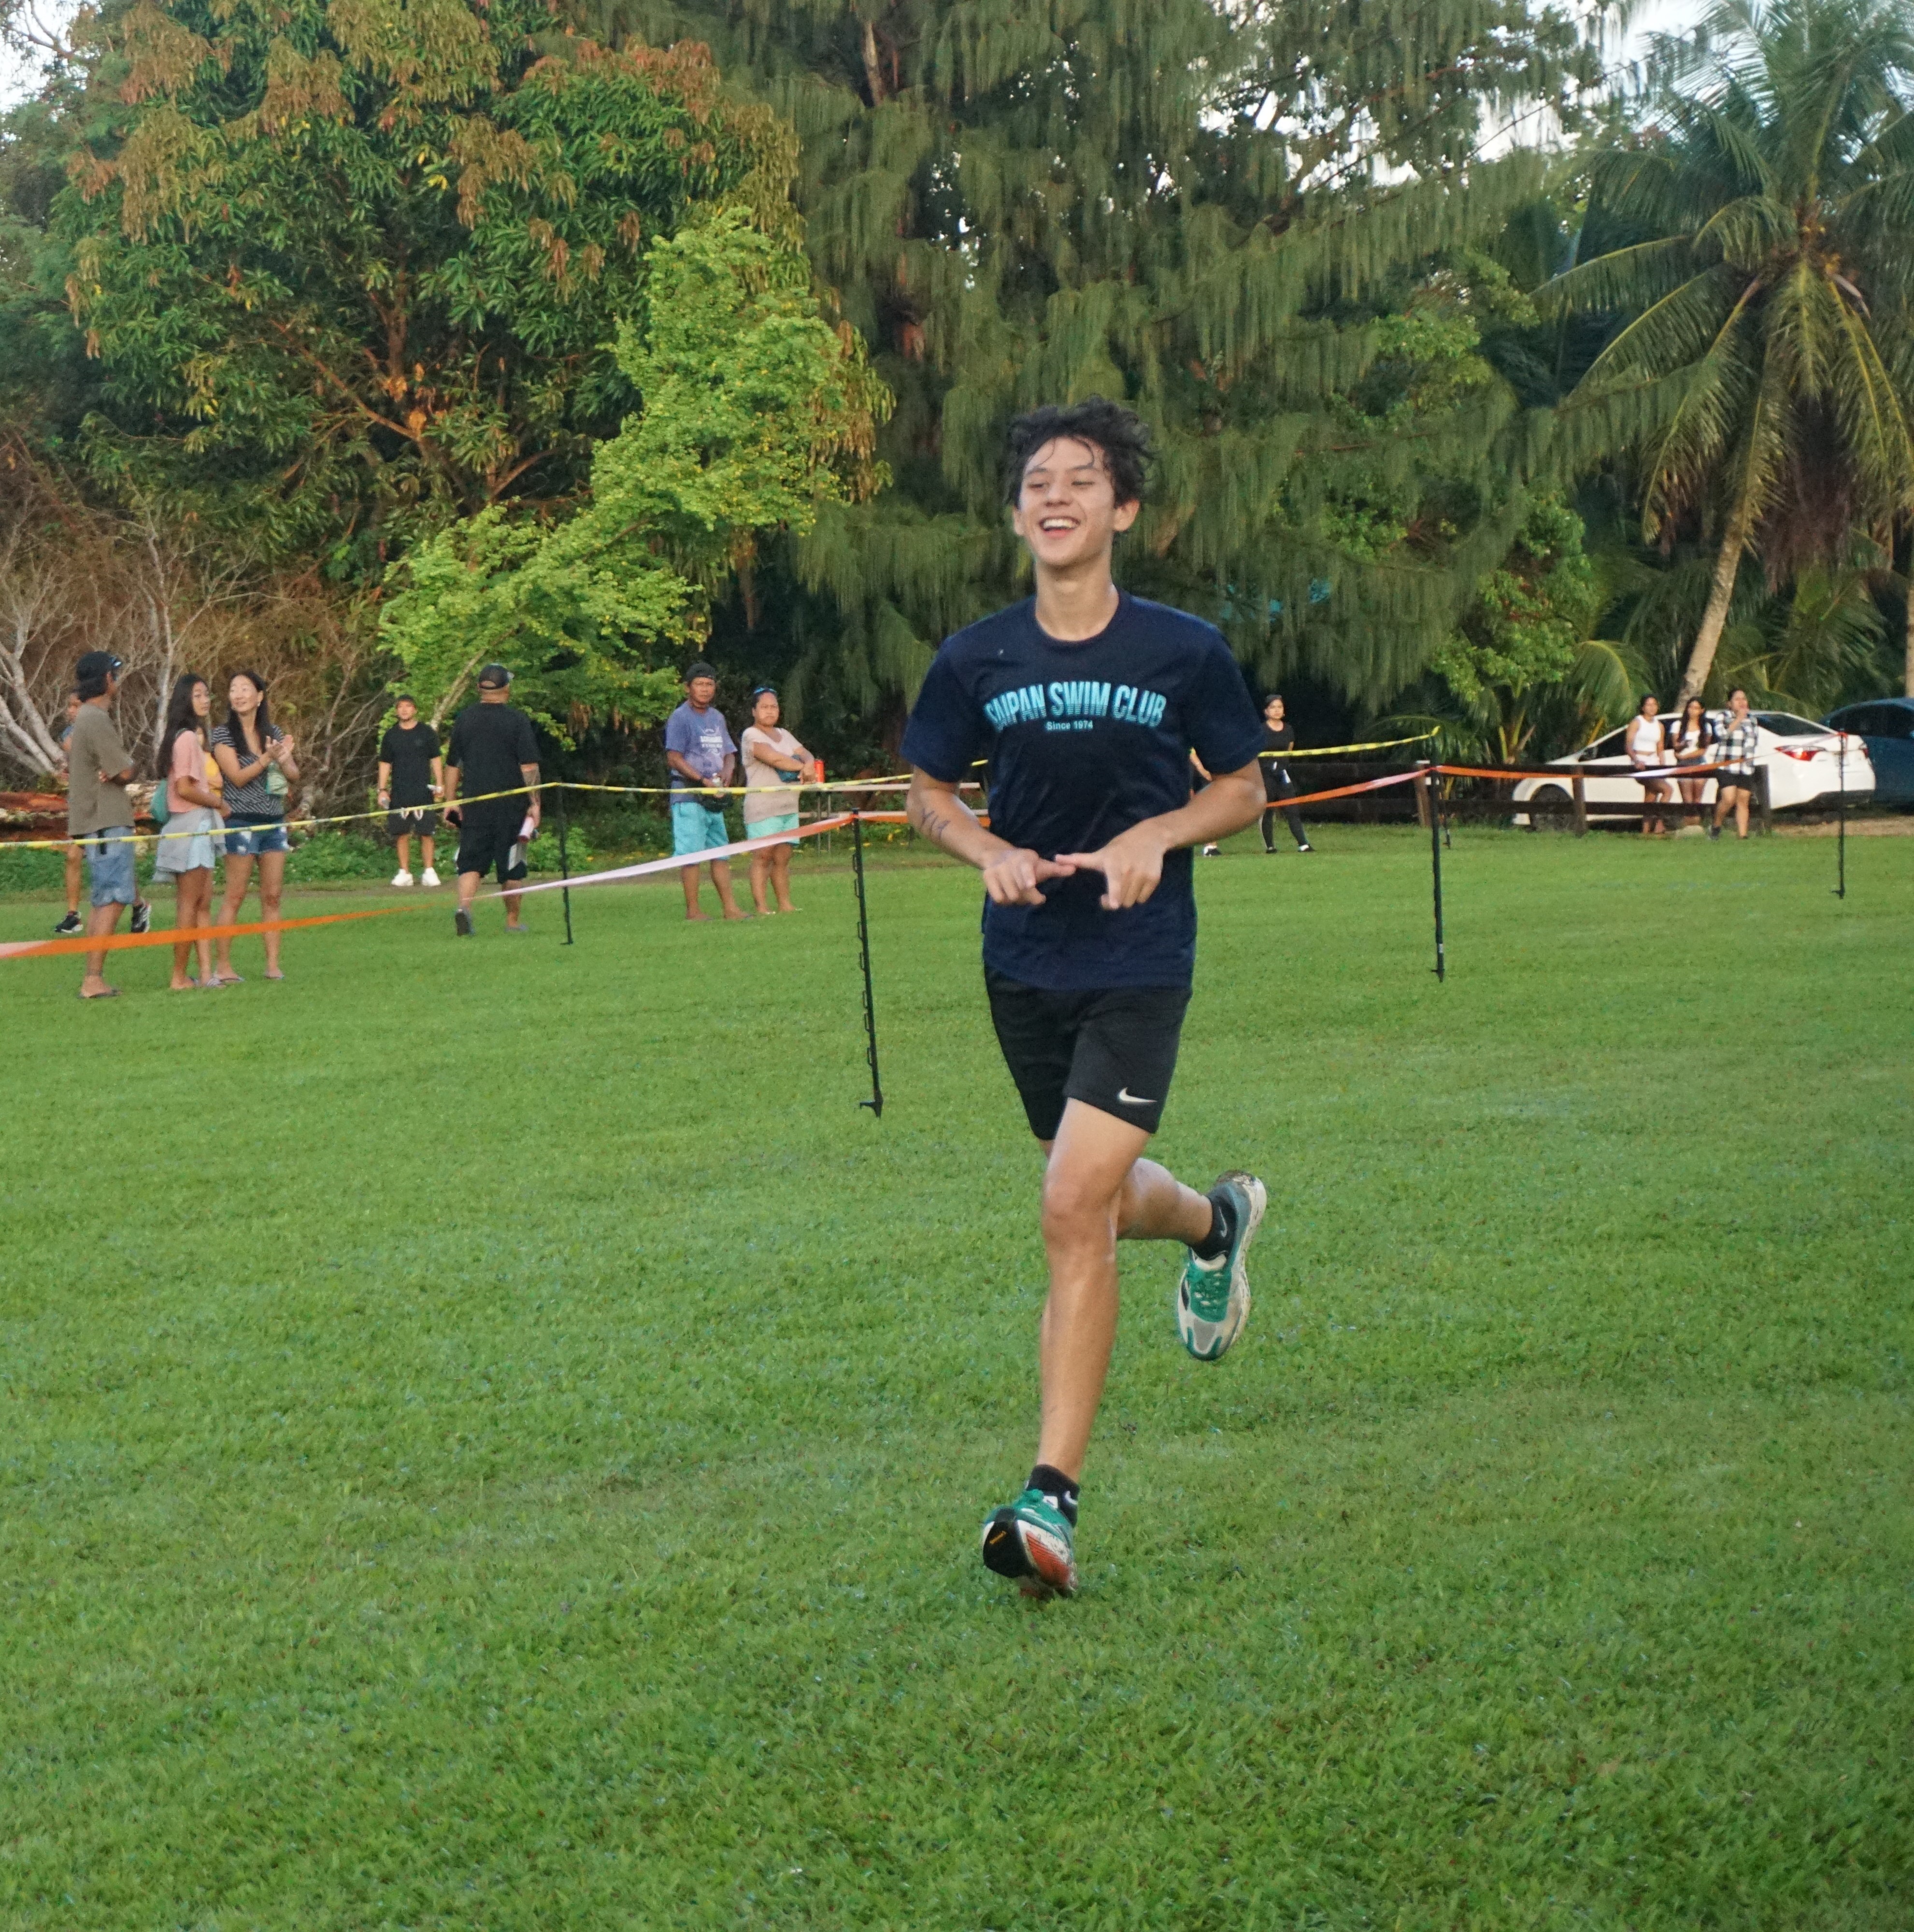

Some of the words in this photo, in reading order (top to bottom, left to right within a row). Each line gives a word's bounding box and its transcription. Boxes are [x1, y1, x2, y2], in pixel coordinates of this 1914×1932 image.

[985, 684, 1047, 732] SAIPAN
[1050, 681, 1112, 716] SWIM
[1113, 684, 1167, 727] CLUB
[1046, 721, 1071, 730] Since
[1073, 720, 1093, 730] 1974
